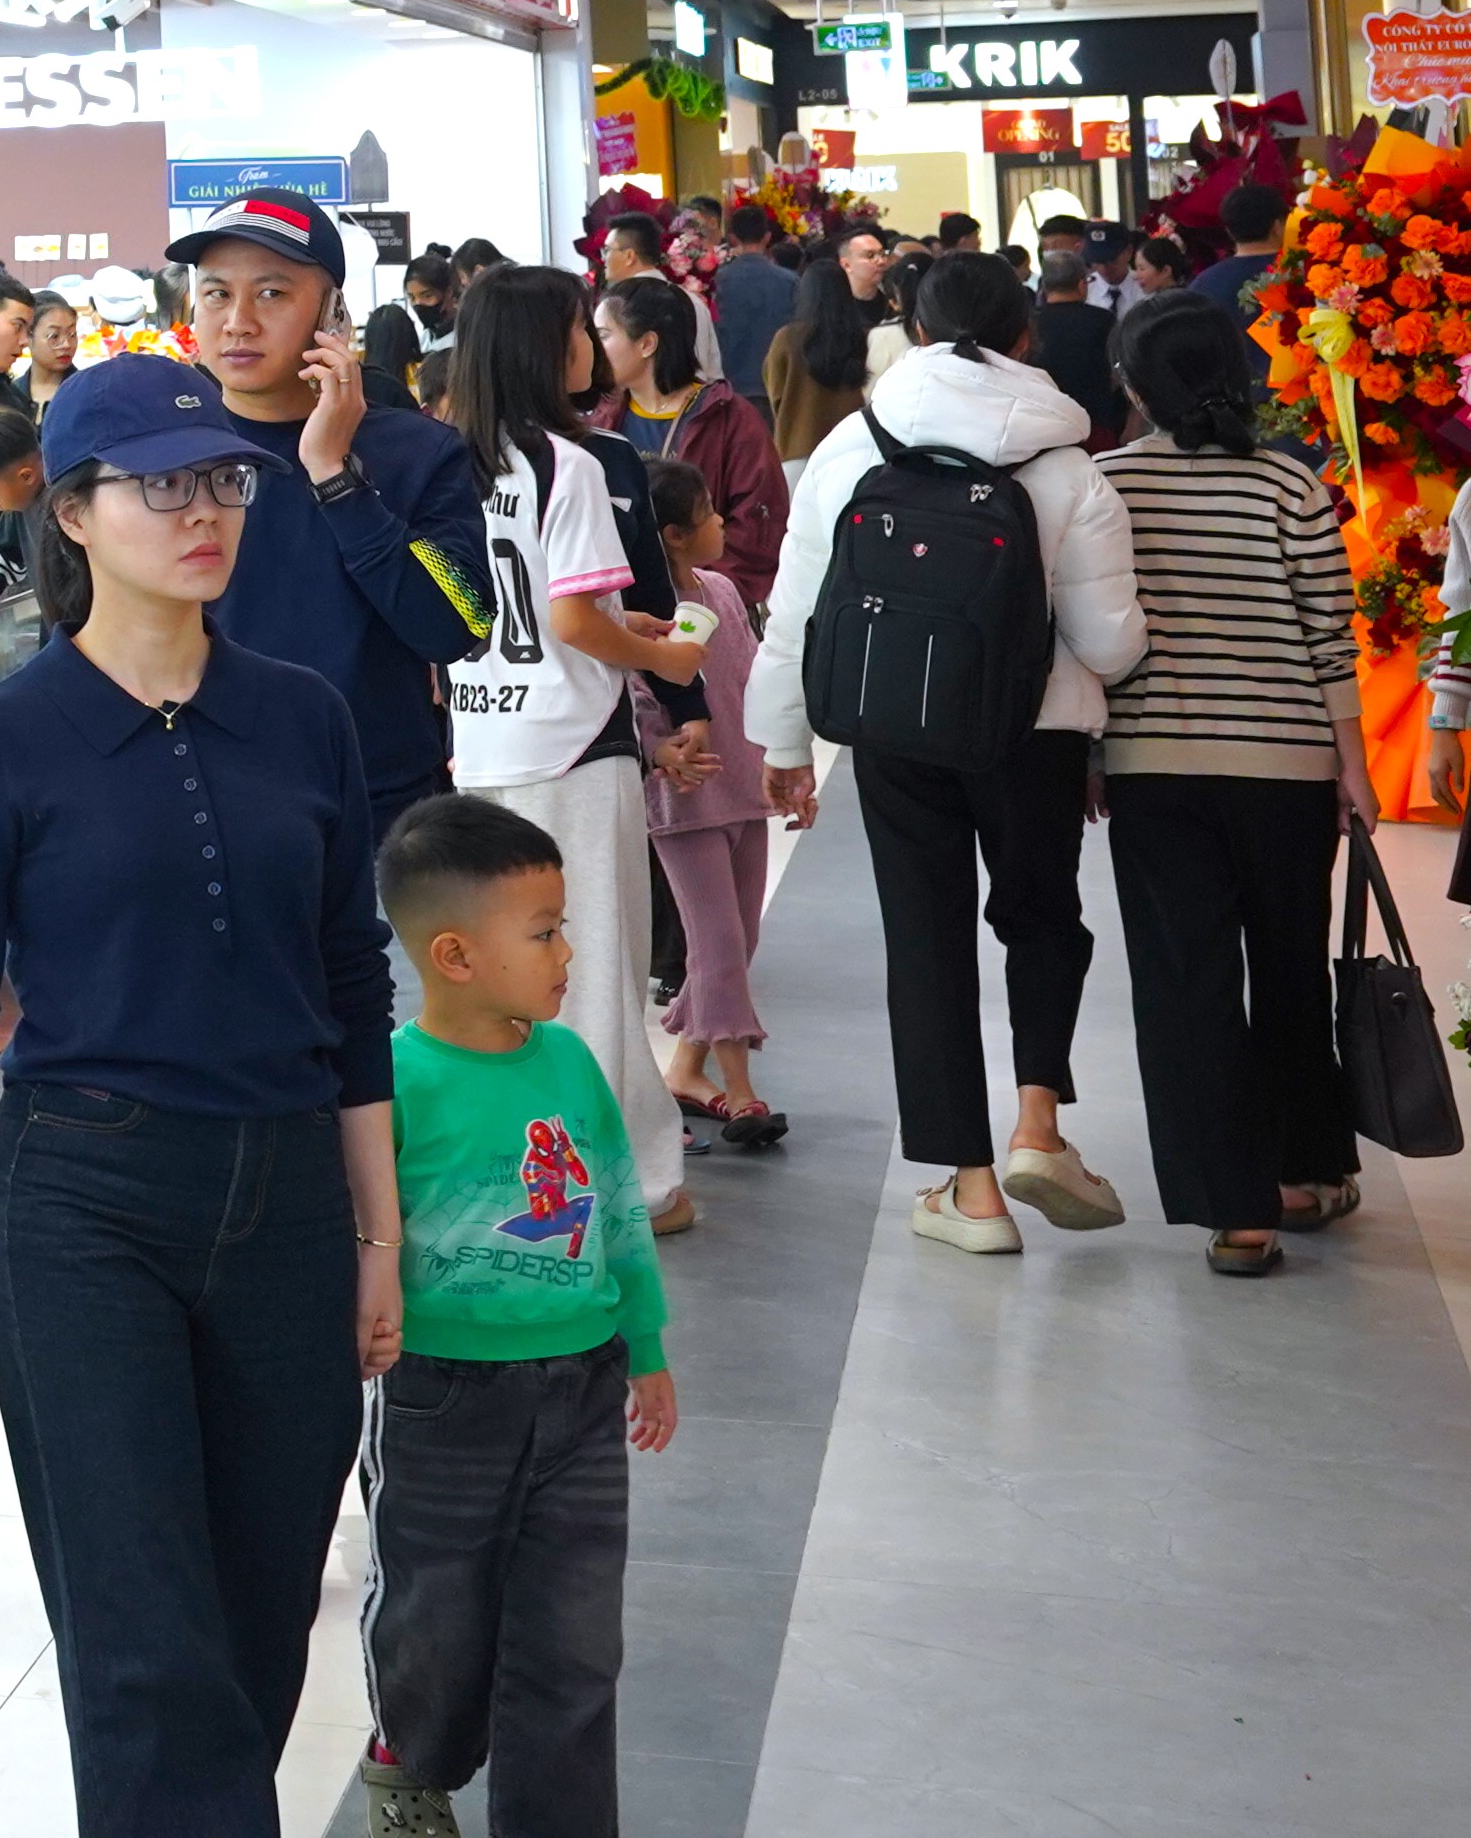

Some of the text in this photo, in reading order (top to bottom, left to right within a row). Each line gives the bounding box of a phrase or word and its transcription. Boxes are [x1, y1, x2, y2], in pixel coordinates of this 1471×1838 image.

[1425, 24, 1442, 35] TY
[929, 39, 1083, 88] KRIK
[1039, 151, 1055, 163] 01
